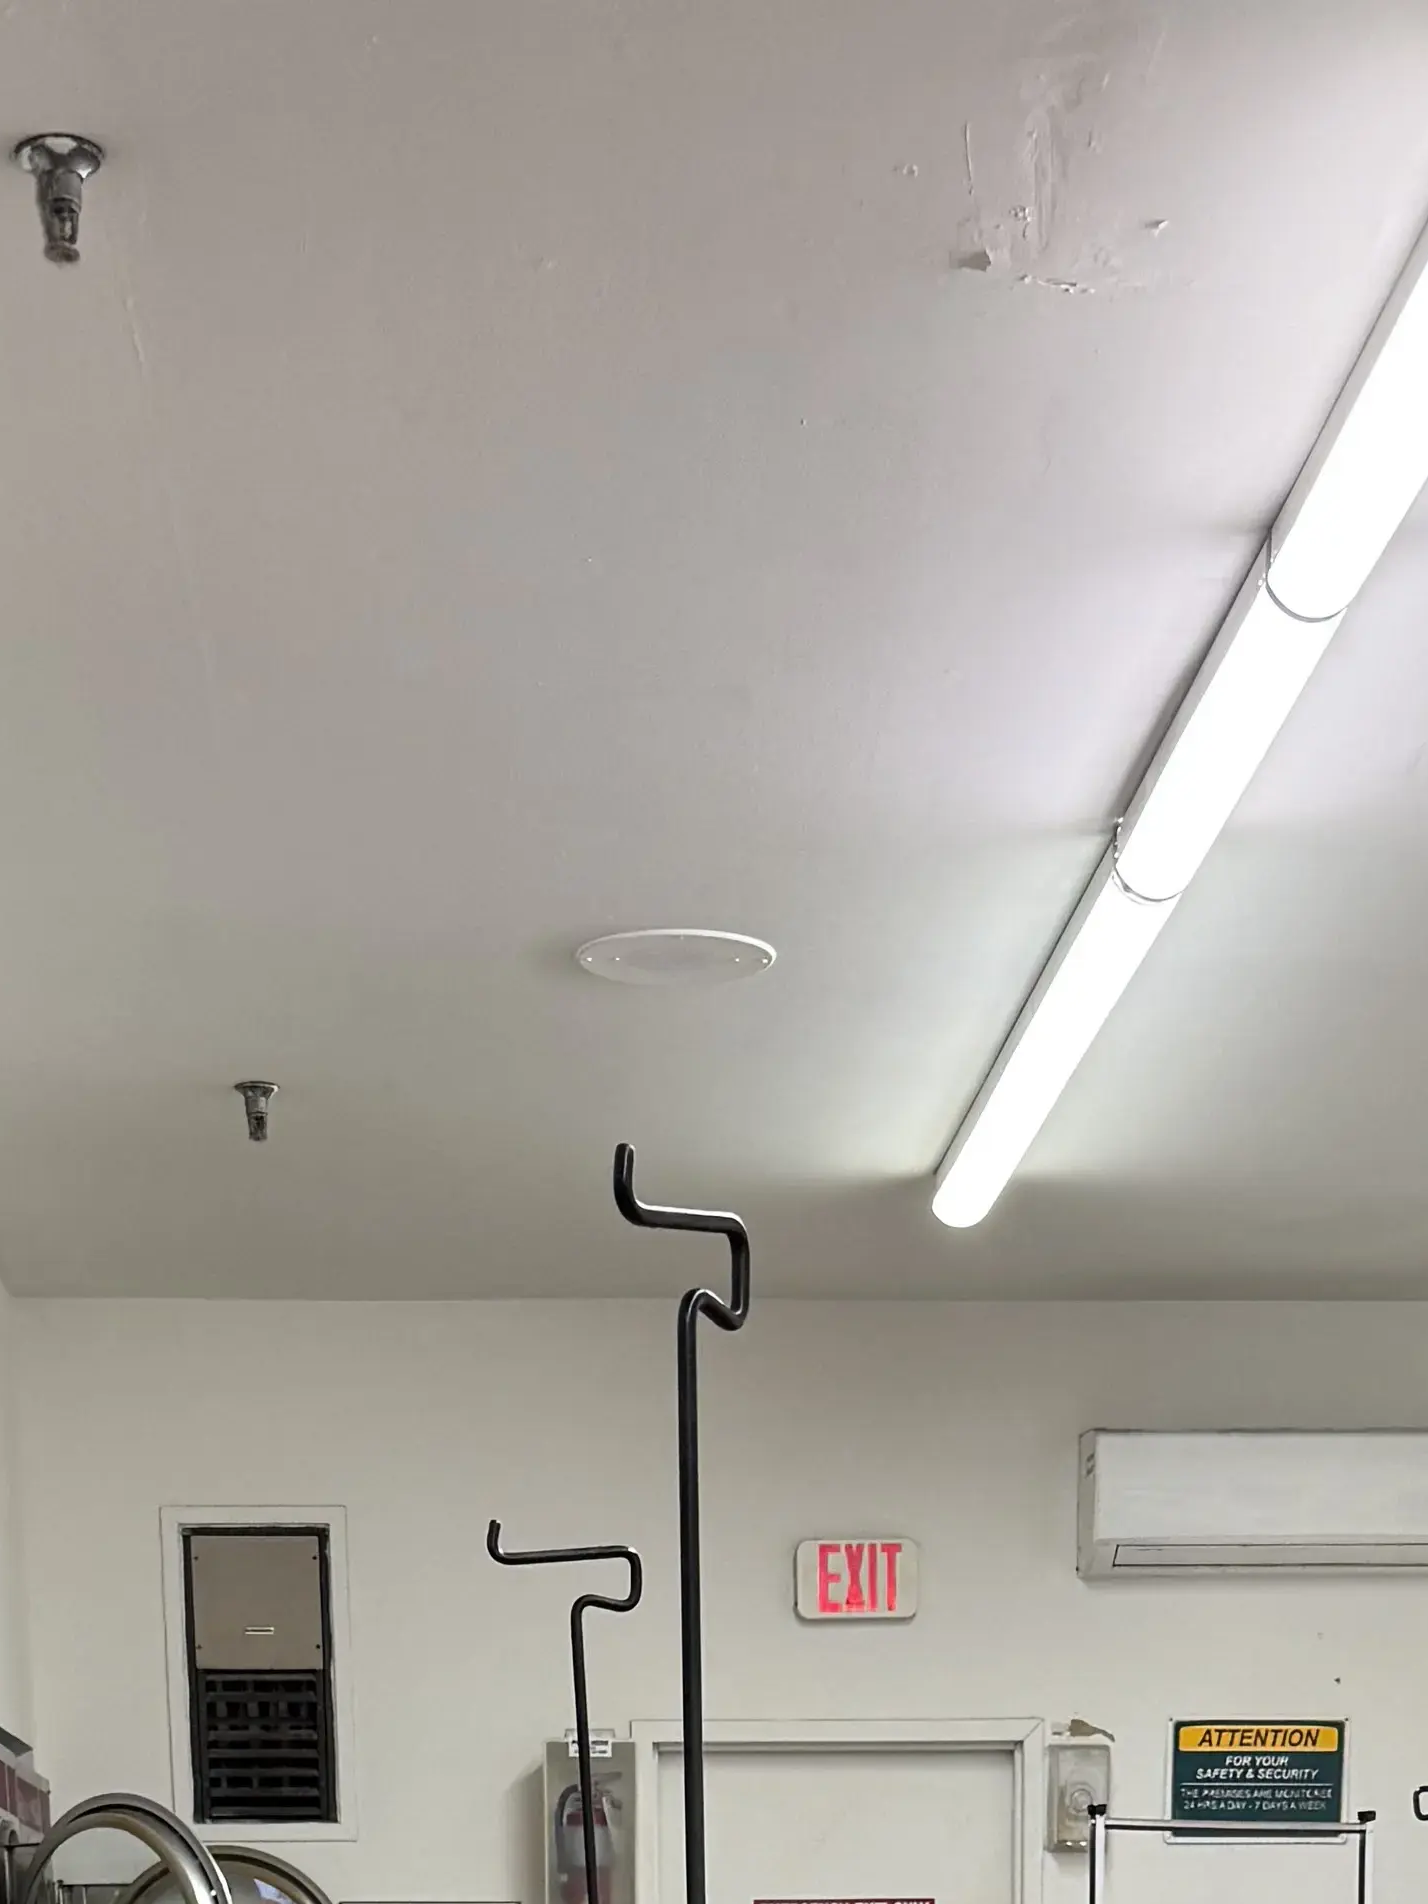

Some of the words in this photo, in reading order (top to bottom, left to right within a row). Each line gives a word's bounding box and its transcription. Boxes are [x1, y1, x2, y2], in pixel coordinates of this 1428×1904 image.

[818, 1542, 902, 1613] EXIT
[1197, 1728, 1321, 1748] ATTENTION
[1225, 1755, 1252, 1766] FOR
[1255, 1755, 1289, 1766] YOUR
[1195, 1768, 1242, 1780] SAFETY
[1246, 1768, 1254, 1779] &
[1257, 1768, 1319, 1780] SECURITY
